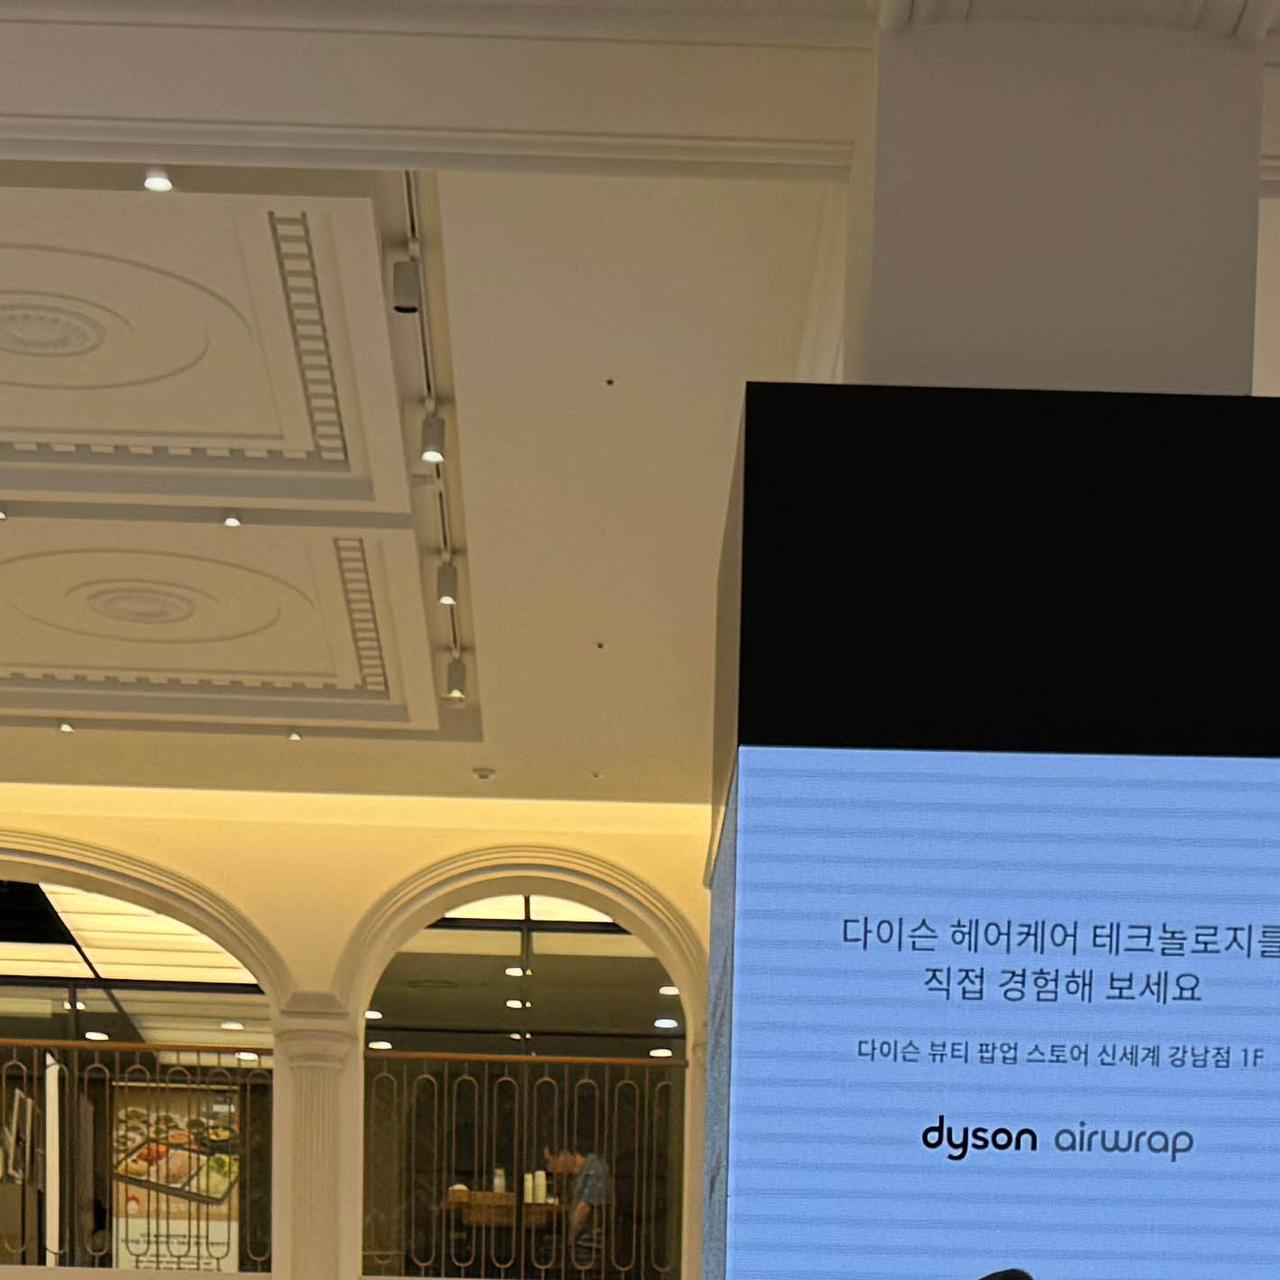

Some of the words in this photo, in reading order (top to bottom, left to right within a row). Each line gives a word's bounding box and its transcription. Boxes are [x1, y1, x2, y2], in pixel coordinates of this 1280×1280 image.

[842, 916, 939, 952] 다이슨
[950, 918, 1078, 956] 헤어케어
[924, 966, 985, 1001] 직접
[998, 967, 1094, 1004] 경험해
[1105, 970, 1202, 1005] 보세요
[857, 1038, 921, 1063] 다이슨
[927, 1040, 969, 1065] 뷰티
[978, 1041, 1018, 1065] 팝업
[1026, 1043, 1089, 1067] 스토어
[1097, 1043, 1160, 1068] 신세계
[1168, 1044, 1231, 1069] 강남점
[1241, 1048, 1264, 1068] 1F
[921, 1114, 1038, 1162] dyson
[1054, 1120, 1194, 1163] airwrap
